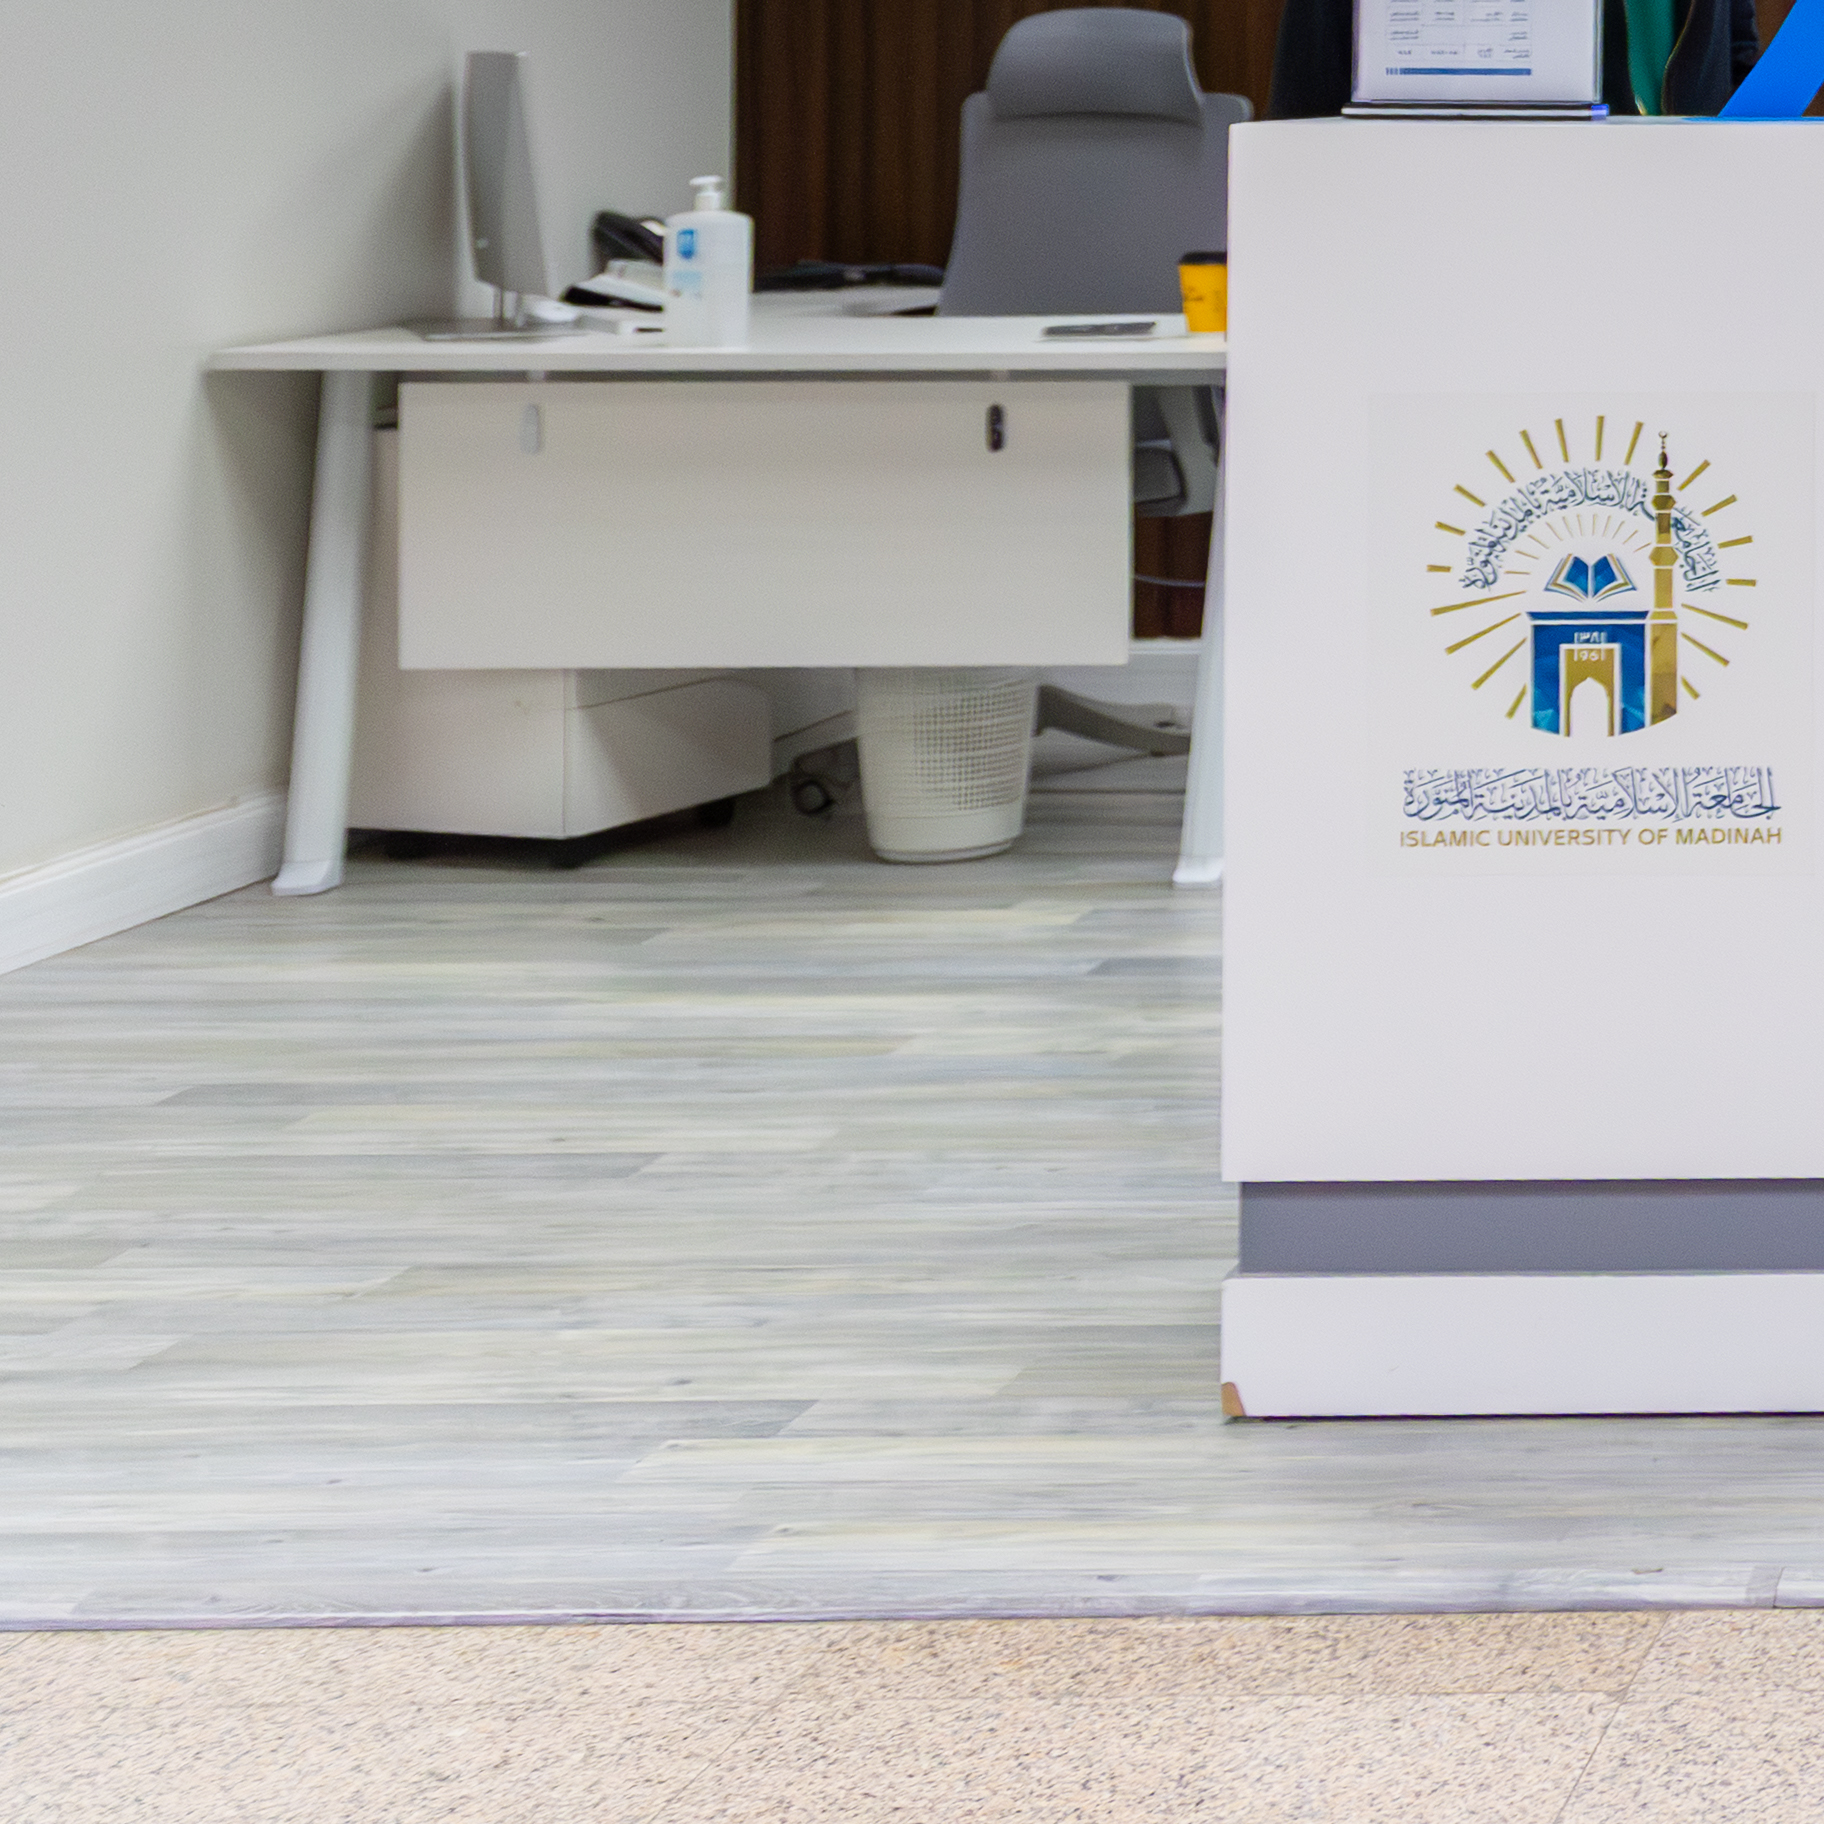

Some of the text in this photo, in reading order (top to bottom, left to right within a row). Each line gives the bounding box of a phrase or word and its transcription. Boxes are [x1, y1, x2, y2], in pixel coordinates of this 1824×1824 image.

[1400, 827, 1782, 847] ISLAMIC UNIVERSITY OF MADINAH
